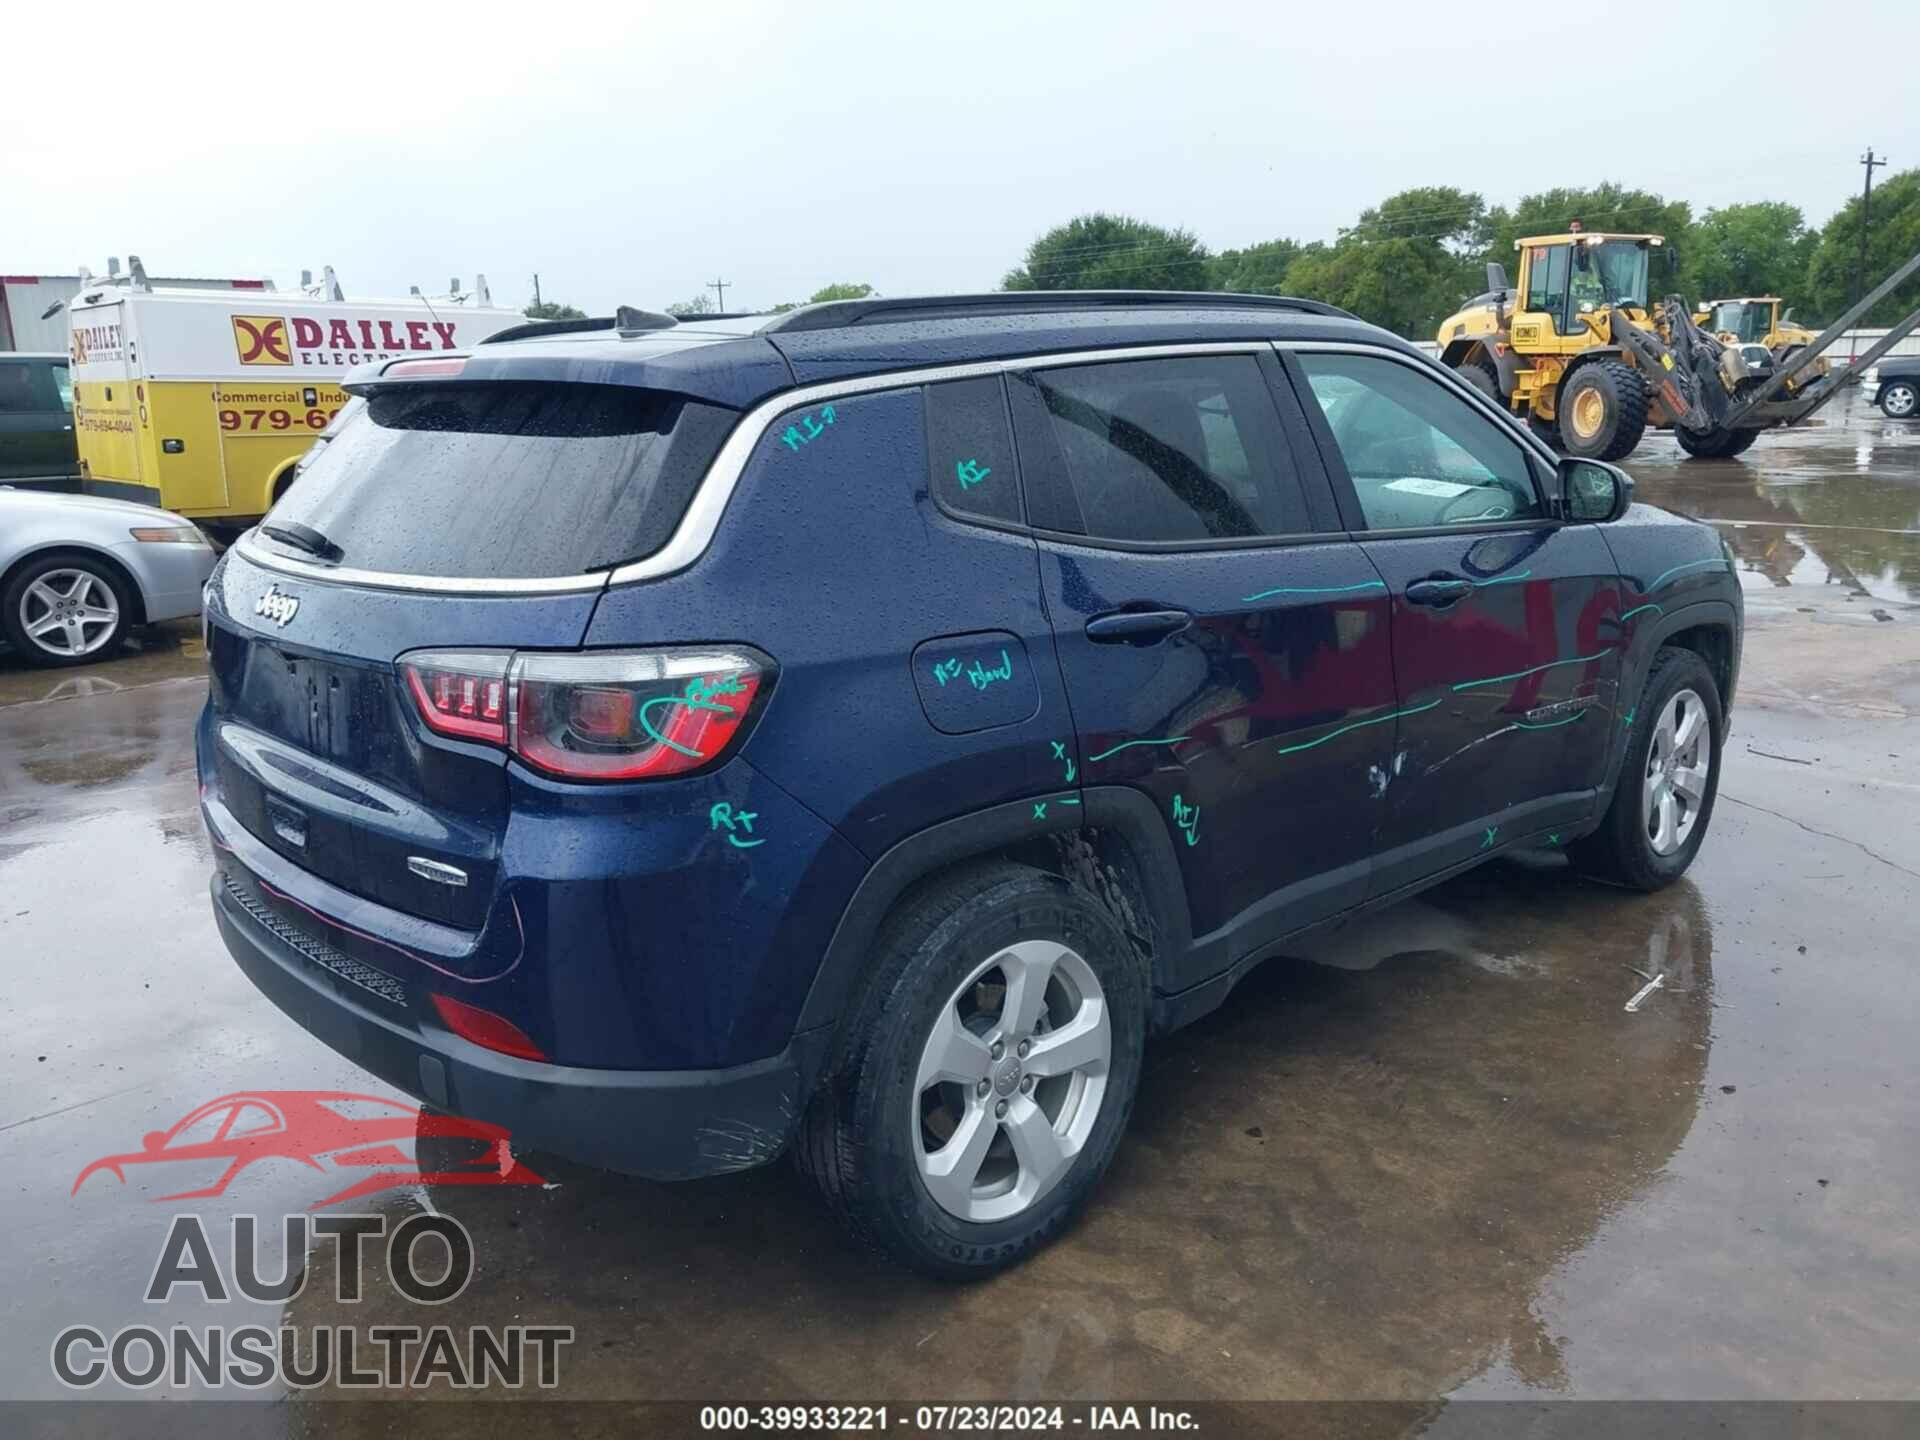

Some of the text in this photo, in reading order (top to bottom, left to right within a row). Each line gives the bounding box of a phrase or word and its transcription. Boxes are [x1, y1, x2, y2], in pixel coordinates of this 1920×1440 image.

[85, 325, 122, 351] DAILEY
[291, 317, 457, 350] DAILEY
[212, 391, 299, 403] Commercial
[255, 583, 301, 629] Jeep
